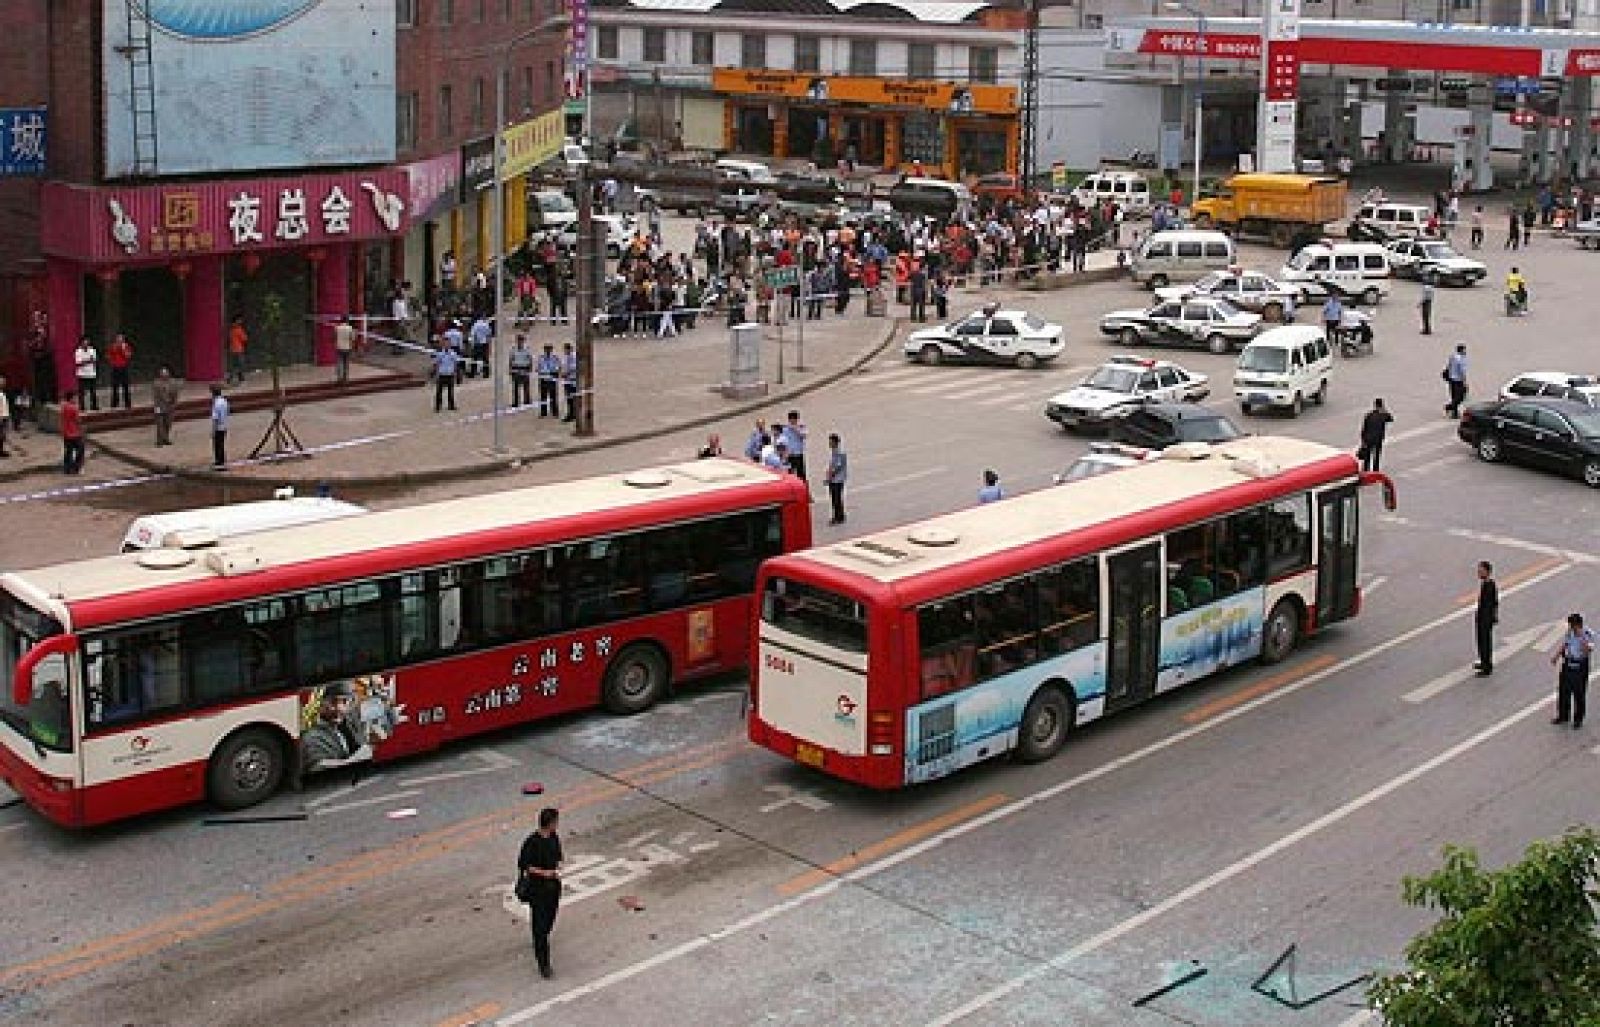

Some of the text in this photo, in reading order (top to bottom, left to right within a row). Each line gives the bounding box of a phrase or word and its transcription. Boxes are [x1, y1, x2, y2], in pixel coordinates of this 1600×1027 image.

[0, 113, 45, 161] 城
[228, 185, 353, 245] 夜总会
